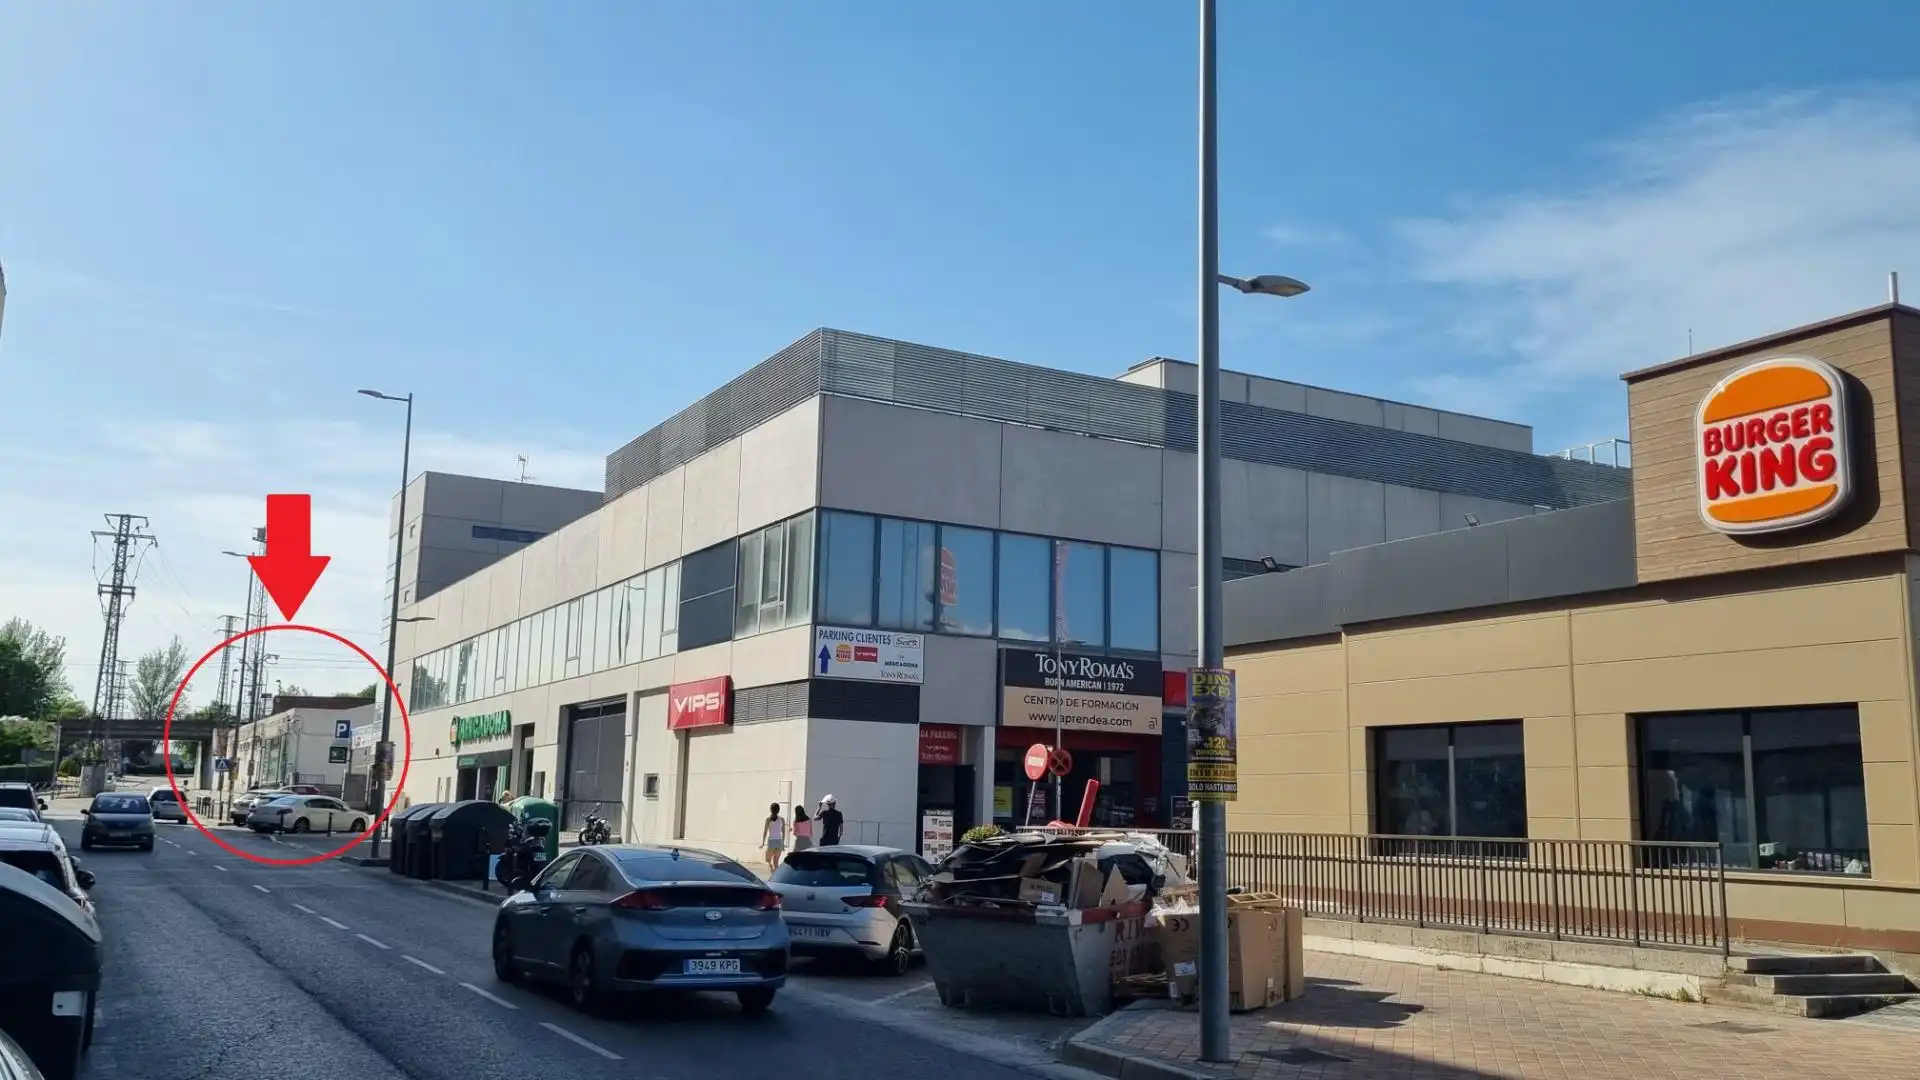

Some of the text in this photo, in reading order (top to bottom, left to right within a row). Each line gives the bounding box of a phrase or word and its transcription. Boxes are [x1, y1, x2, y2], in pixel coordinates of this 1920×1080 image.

[1703, 403, 1834, 457] BURGER
[1705, 437, 1837, 500] KING
[819, 629, 854, 642] PARKING
[855, 632, 891, 645] CLIENTES
[1044, 677, 1125, 692] BORN AMERICAN 1972
[674, 692, 719, 713] VIPS
[1023, 695, 1139, 712] CENTRO DE FORMACIÓN
[691, 960, 738, 971] 3949 KPG
